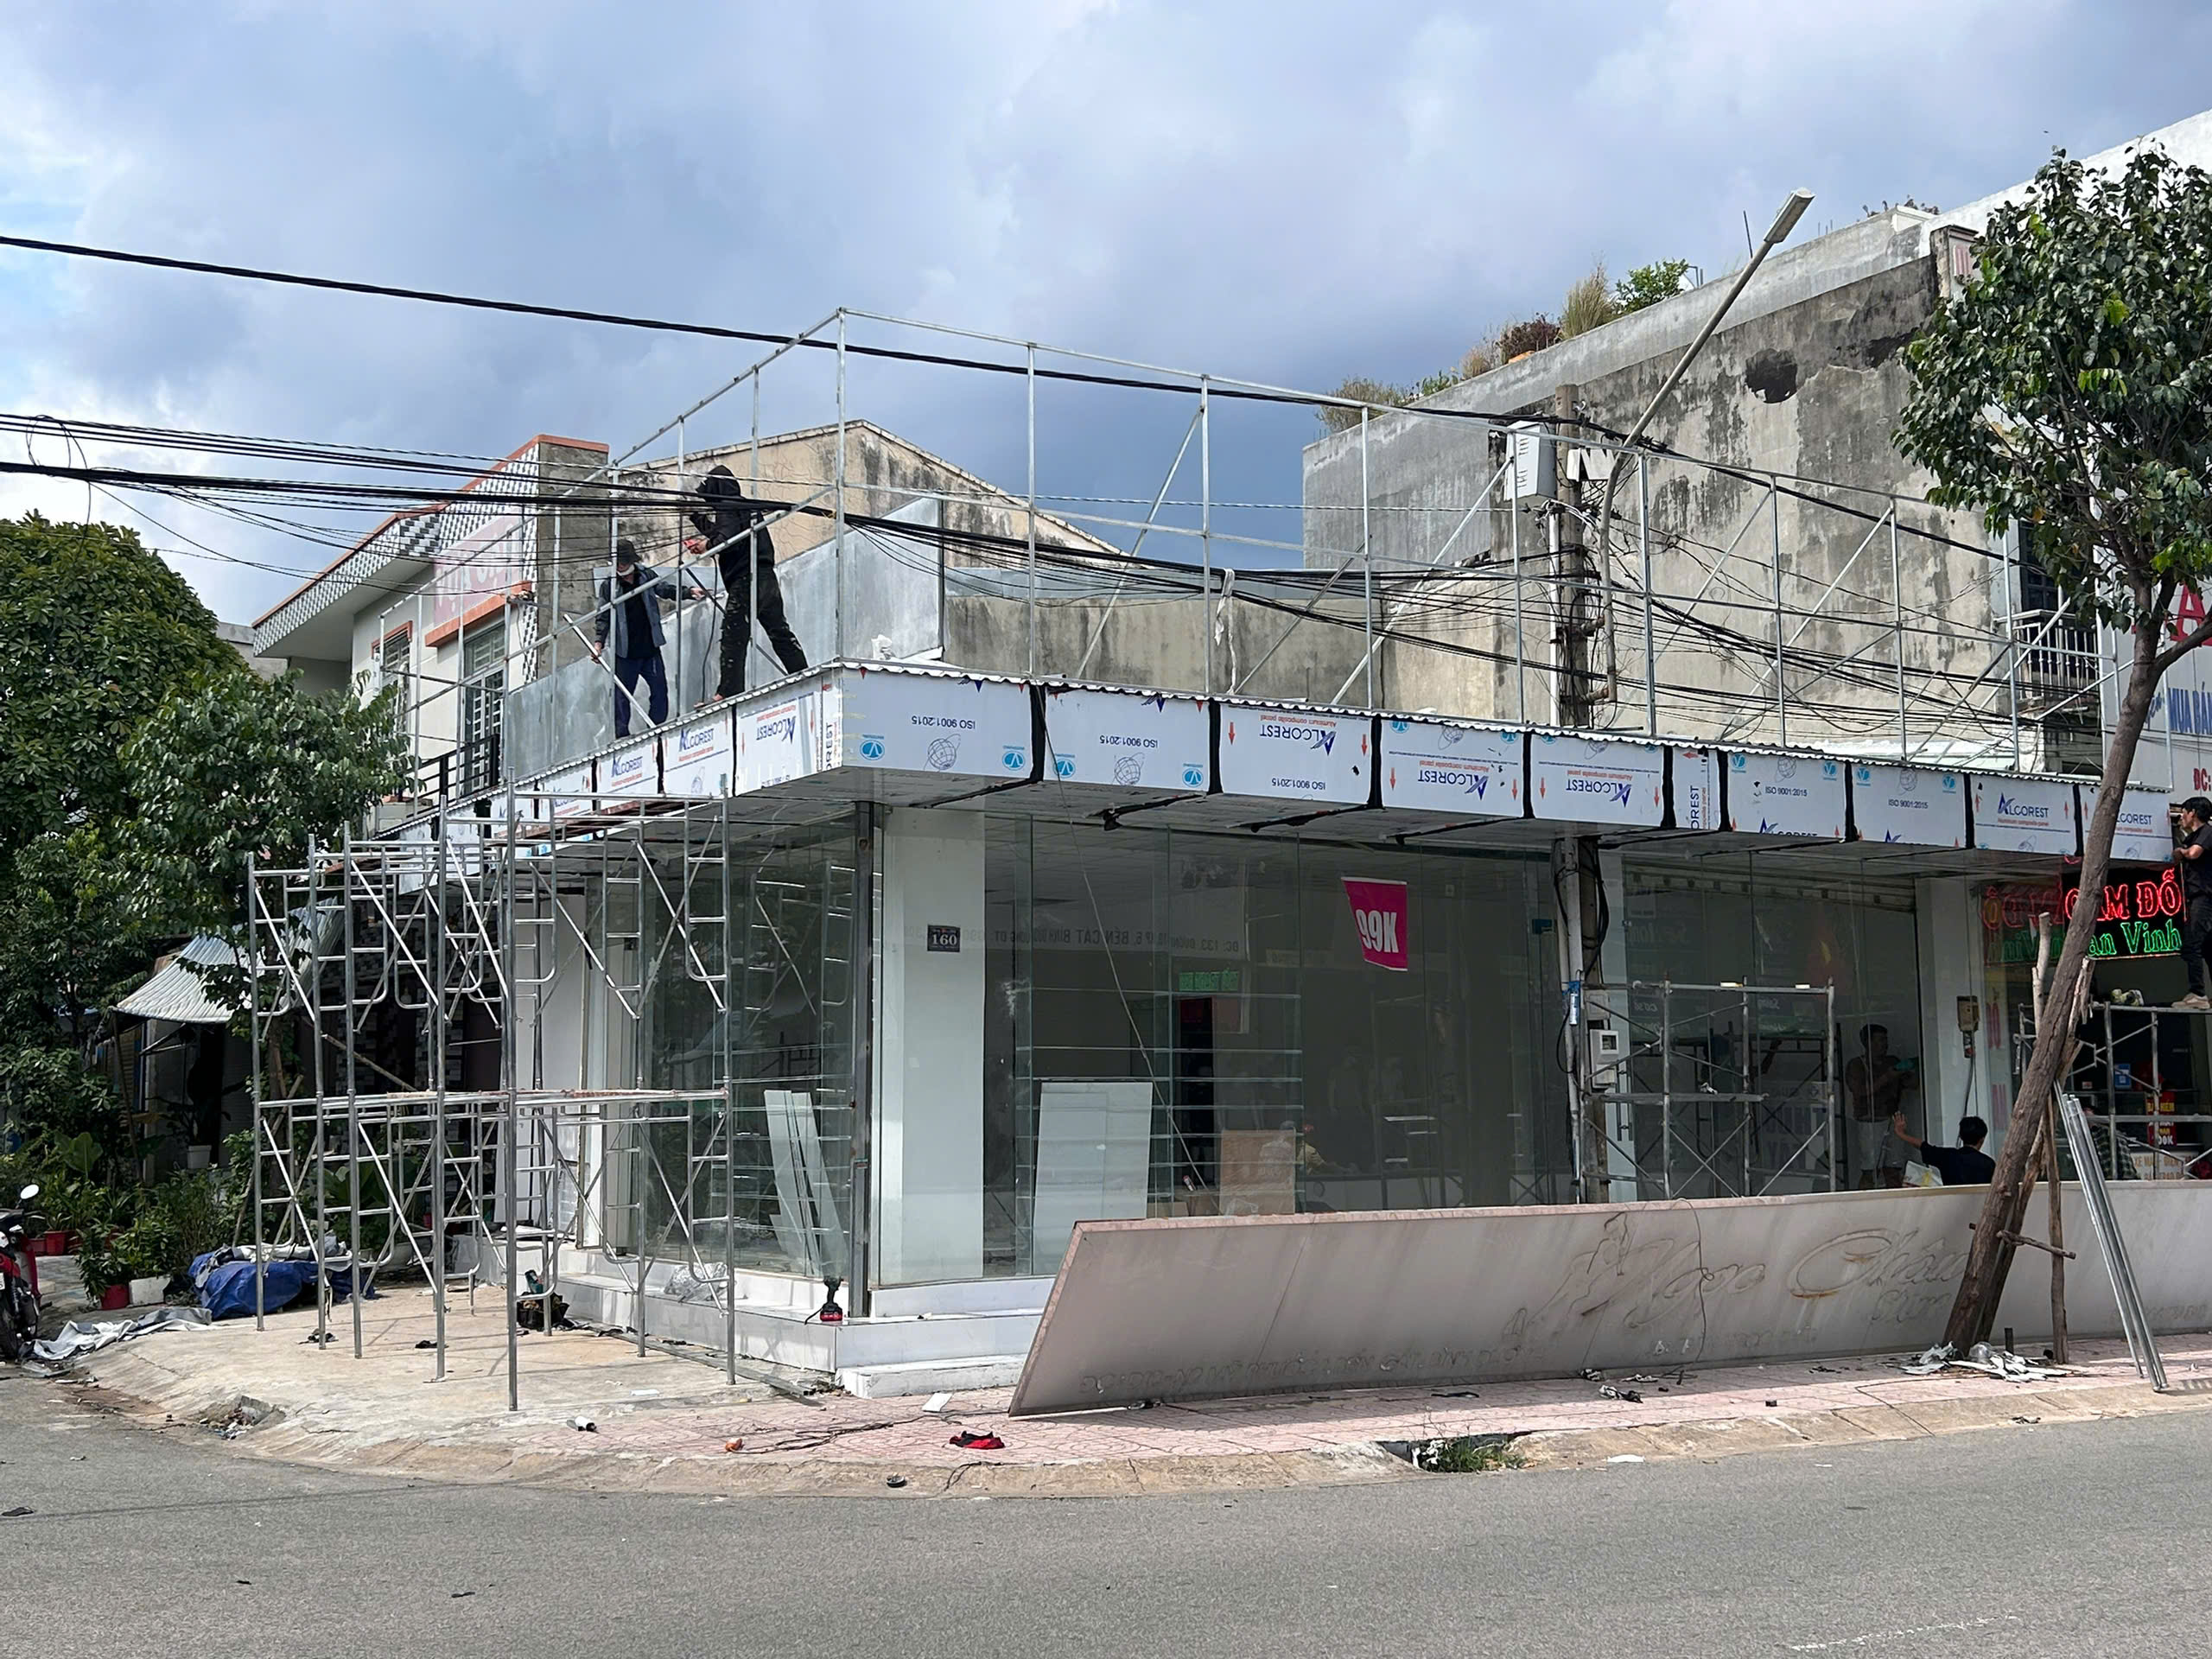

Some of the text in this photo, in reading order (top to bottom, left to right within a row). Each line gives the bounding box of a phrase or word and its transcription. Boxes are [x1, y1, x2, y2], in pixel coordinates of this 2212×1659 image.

[756, 716, 796, 745] ALCOREST
[912, 715, 976, 729] ISO 9001:2015
[679, 728, 714, 752] ALCOREST
[1099, 734, 1158, 749] ISO 9001:2015
[1259, 724, 1337, 756] ALCOREST
[1271, 778, 1325, 790] ISO 9001:2015
[1418, 770, 1489, 800] ALCOREST
[1566, 779, 1631, 808] ALCOREST
[1765, 786, 1777, 795] ISO
[1998, 792, 2049, 818] ALCOREST
[2064, 881, 2131, 922] CM
[932, 933, 957, 945] 160
[1355, 908, 1399, 953] 99K
[2087, 918, 2183, 957] an Vinh
